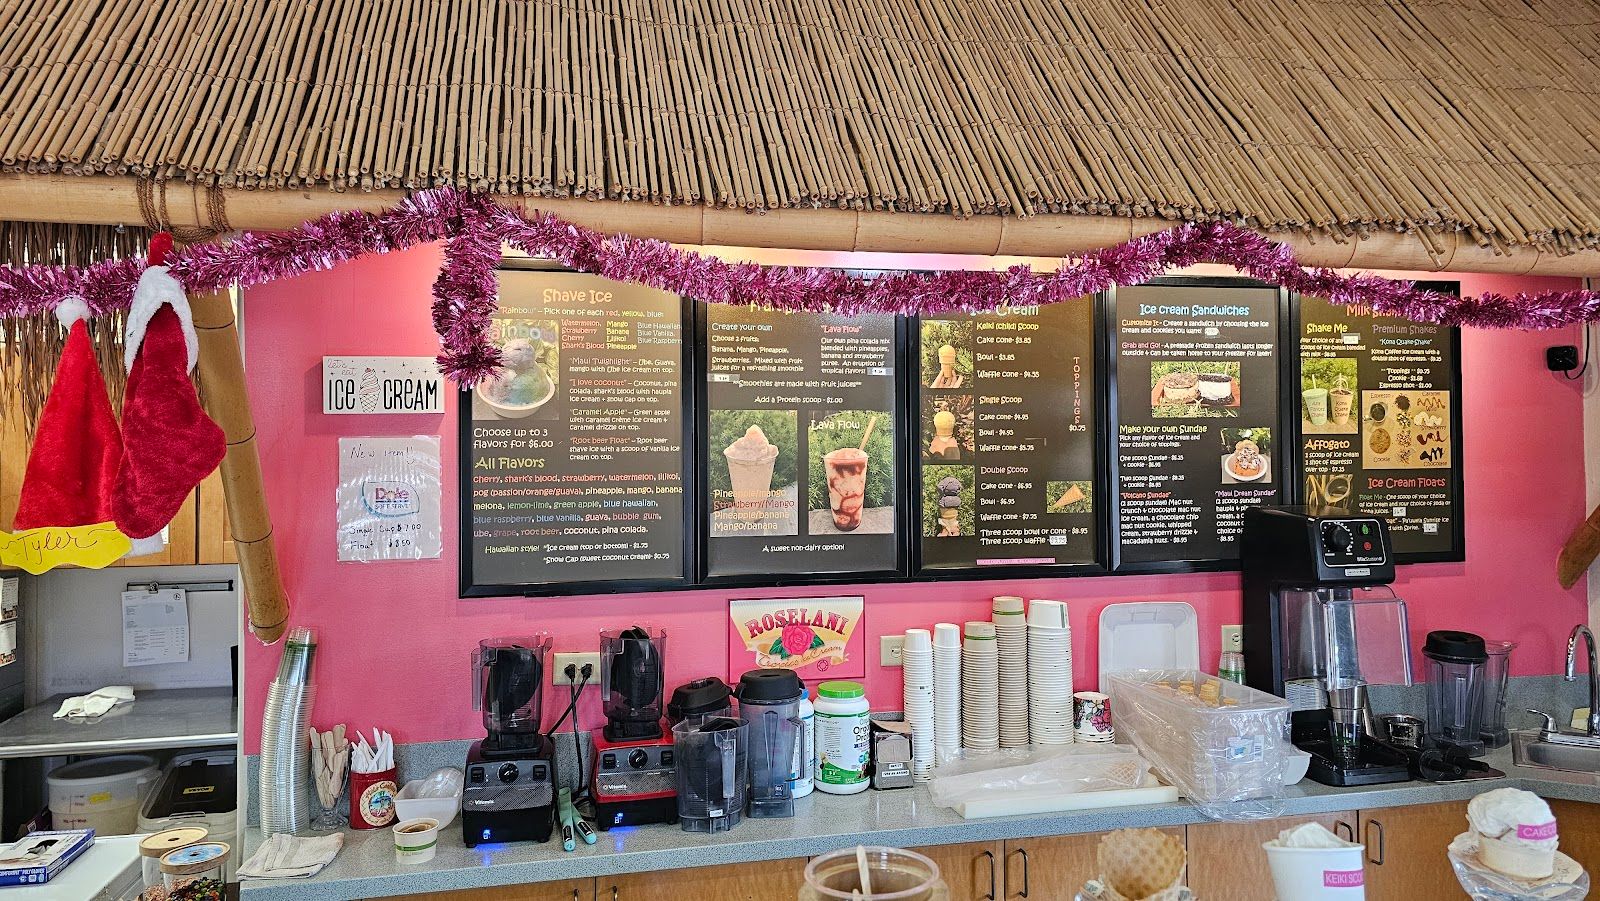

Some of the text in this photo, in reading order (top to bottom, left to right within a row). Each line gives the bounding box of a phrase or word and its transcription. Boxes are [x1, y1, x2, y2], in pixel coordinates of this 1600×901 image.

[543, 288, 612, 303] Shave Ice
[1140, 304, 1249, 317] Ice cream Sandwiches
[1346, 304, 1371, 317] Milk
[712, 323, 738, 331] Create
[739, 324, 756, 332] your
[977, 322, 994, 330] Keiki
[1018, 323, 1039, 331] Scoop
[1306, 323, 1348, 334] Shake Me
[1372, 324, 1437, 335] Premium Shakes
[737, 346, 759, 354] Mango,
[760, 346, 789, 354] Pineapple,
[976, 353, 994, 361] Bowl
[786, 380, 802, 388] made
[821, 380, 836, 388] fruit
[328, 378, 438, 410] ICE CREAM
[979, 396, 1022, 404] Single Scoop
[811, 419, 860, 431] Lava Flow
[1069, 424, 1086, 432] $0.75
[1120, 425, 1141, 434] Make
[1179, 425, 1208, 434] Sundae
[474, 428, 548, 438] Choose up to 3
[473, 439, 553, 449] flavors for $6.00
[1304, 439, 1350, 450] Affogato
[351, 444, 375, 459] New
[474, 457, 545, 470] All Flavors
[980, 466, 1028, 474] Double Scoop
[473, 475, 502, 484] cherry,
[504, 475, 532, 483] shark's
[535, 474, 560, 483] blood,
[562, 474, 607, 483] strawberry,
[609, 474, 656, 482] watermelon,
[1368, 478, 1446, 489] Ice Cream Floats
[980, 482, 997, 490] Cake
[375, 487, 409, 500] Dole
[473, 489, 488, 498] pog
[585, 487, 625, 496] pineapple,
[627, 486, 654, 495] mango,
[656, 486, 683, 494] banana
[473, 502, 505, 511] melona,
[553, 501, 576, 510] green
[578, 501, 601, 509] apple,
[622, 499, 658, 507] hawaiian,
[980, 498, 995, 506] Bowl
[473, 513, 661, 524] blue raspberry, blue vanilla, guava, bubble gum,
[473, 525, 648, 538] ube, grape, root beer, coconut, pina colada.
[714, 522, 777, 531] Mango/banana
[1072, 527, 1088, 535] $8.95
[17, 531, 98, 565] Tyler
[762, 545, 769, 553] A
[791, 544, 820, 552] non-dairy
[745, 608, 849, 639] ROSELANI
[1326, 874, 1347, 883] KEIKI
